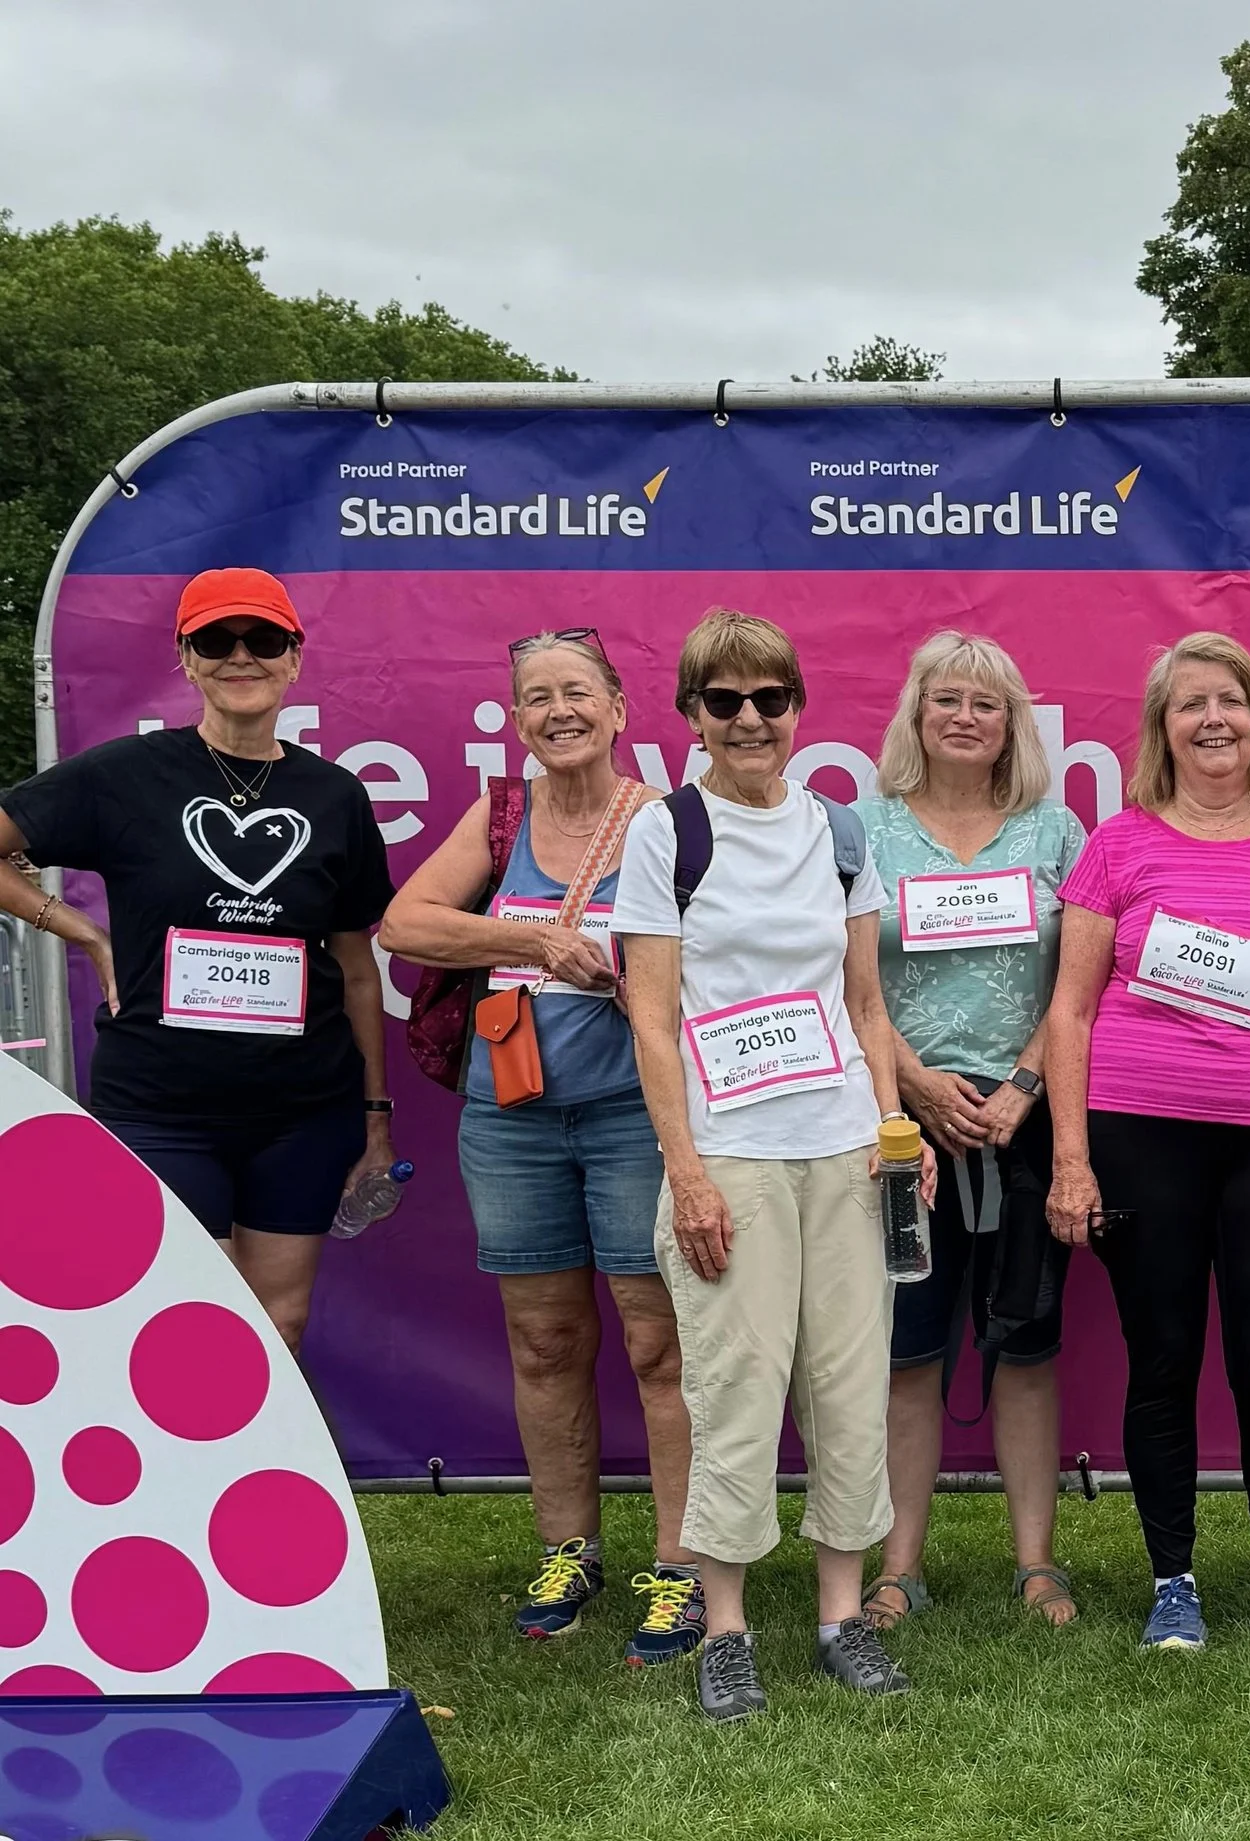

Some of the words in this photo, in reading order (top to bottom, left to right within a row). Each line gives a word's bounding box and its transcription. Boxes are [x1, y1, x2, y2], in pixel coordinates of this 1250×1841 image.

[340, 464, 392, 479] Proud
[398, 464, 466, 478] Partner
[810, 461, 863, 476] Proud
[869, 461, 938, 476] Partner
[340, 493, 544, 537] Standard
[559, 493, 646, 537] Life
[810, 491, 1020, 535] Standard
[1032, 491, 1118, 535] Life
[206, 893, 283, 916] Cambridge
[937, 893, 998, 907] 20696
[504, 912, 560, 925] Cambrid
[580, 919, 608, 928] idows
[178, 946, 250, 961] Cambridge
[254, 951, 300, 964] Widows
[1177, 944, 1235, 973] 20691
[208, 966, 270, 985] 20418
[208, 995, 220, 1004] for
[700, 1015, 769, 1041] Cambridge
[772, 1007, 817, 1021] Widows
[736, 1027, 796, 1056] 20510
